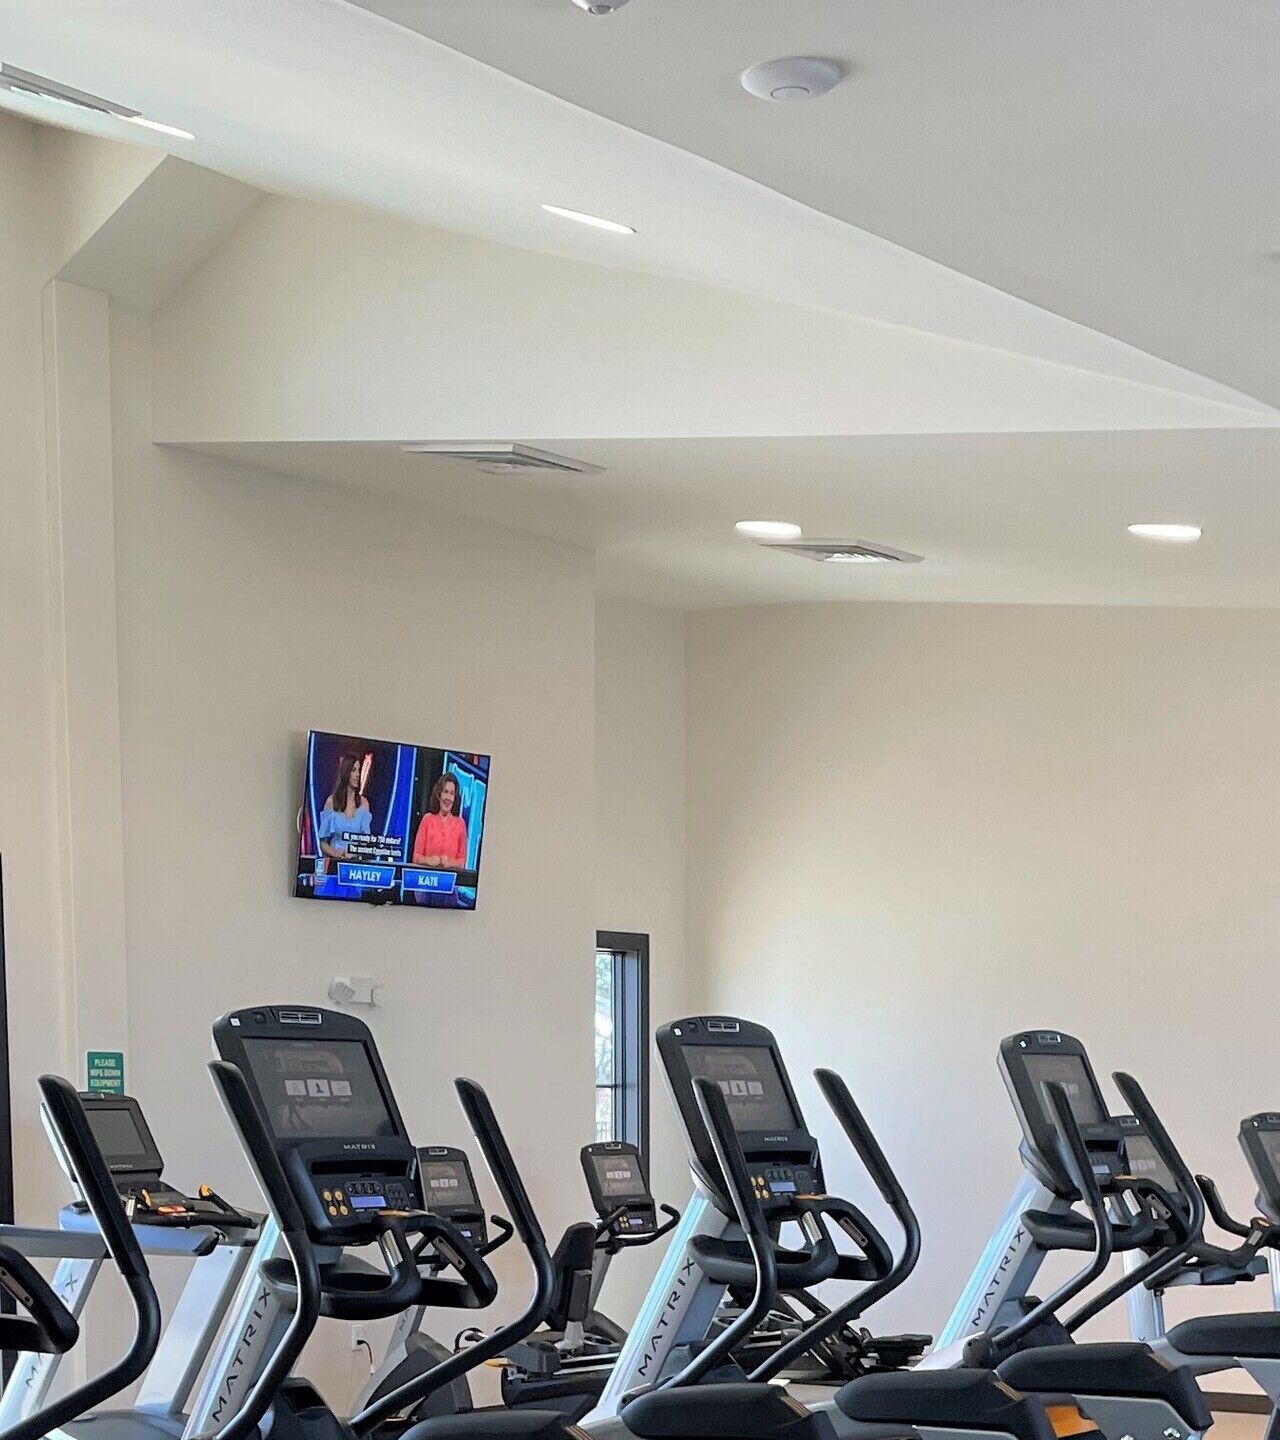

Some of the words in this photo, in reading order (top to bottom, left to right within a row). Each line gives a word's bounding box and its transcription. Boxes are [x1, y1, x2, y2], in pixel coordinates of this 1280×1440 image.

[349, 869, 382, 882] HAYLEY
[418, 875, 439, 887] KATE
[637, 1256, 696, 1377] MATRIX
[971, 1227, 1026, 1327] MATRIX
[212, 1286, 271, 1422] MATRIX
